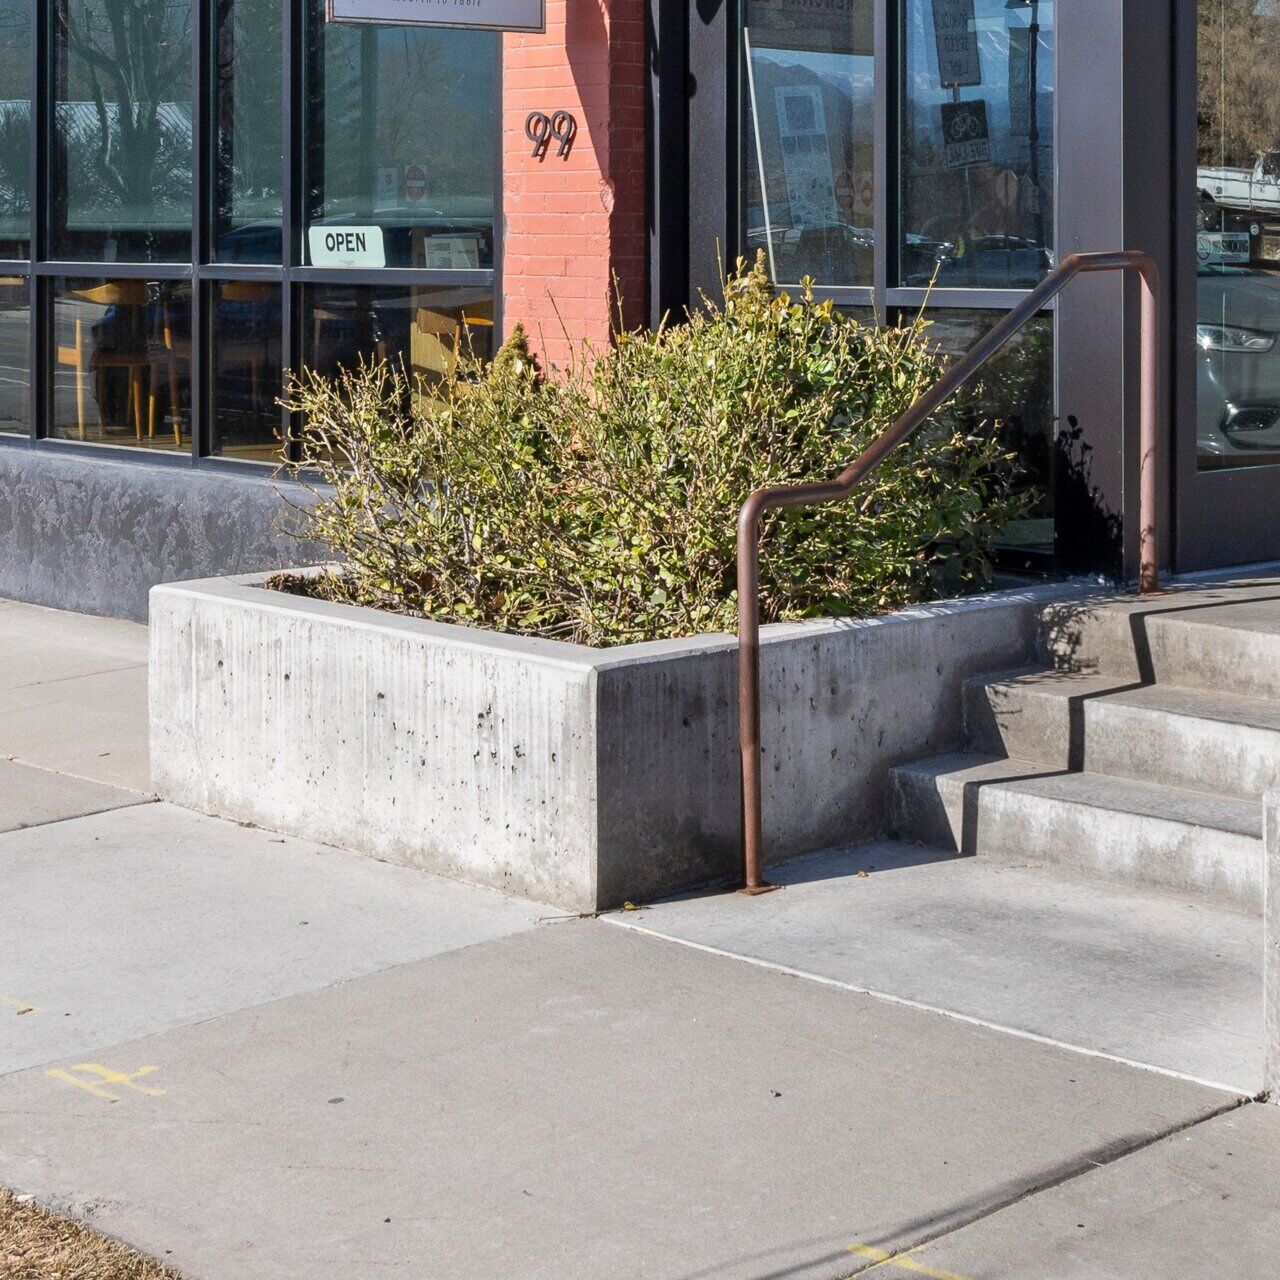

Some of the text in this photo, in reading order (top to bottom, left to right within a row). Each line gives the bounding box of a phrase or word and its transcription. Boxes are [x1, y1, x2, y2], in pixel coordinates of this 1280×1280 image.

[525, 110, 573, 157] 99
[325, 232, 367, 252] OPEN
[1221, 239, 1249, 253] SMOKING
